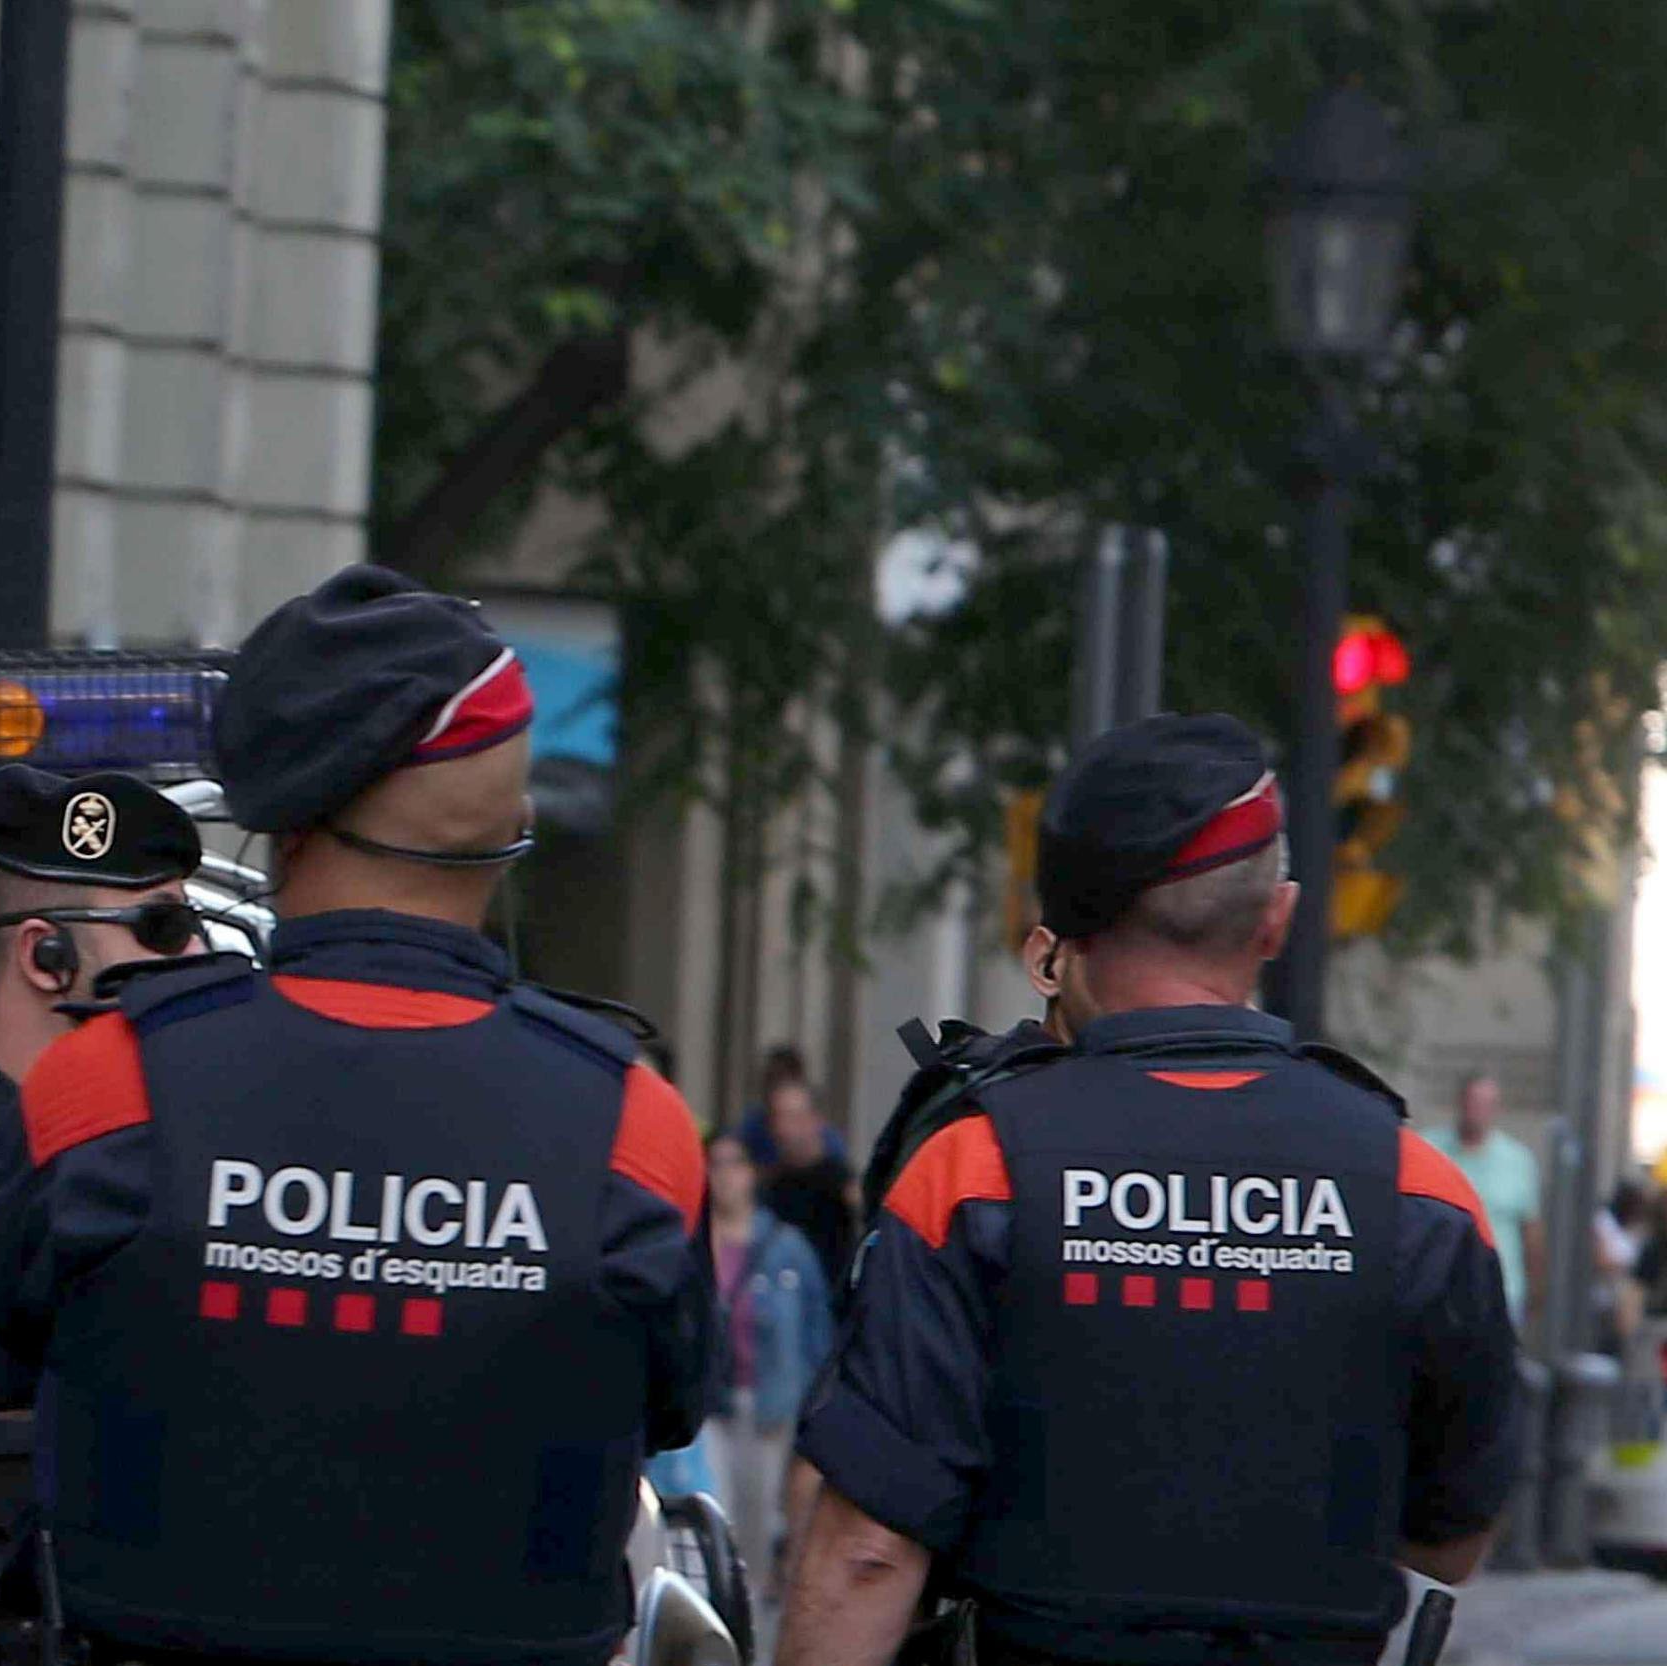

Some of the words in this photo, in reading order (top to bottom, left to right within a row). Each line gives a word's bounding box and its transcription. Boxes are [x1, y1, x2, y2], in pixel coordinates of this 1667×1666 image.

[206, 1159, 549, 1252] POLICIA
[1062, 1168, 1354, 1238] POLICIA
[204, 1240, 345, 1280] mossos
[1062, 1238, 1183, 1267] mossos
